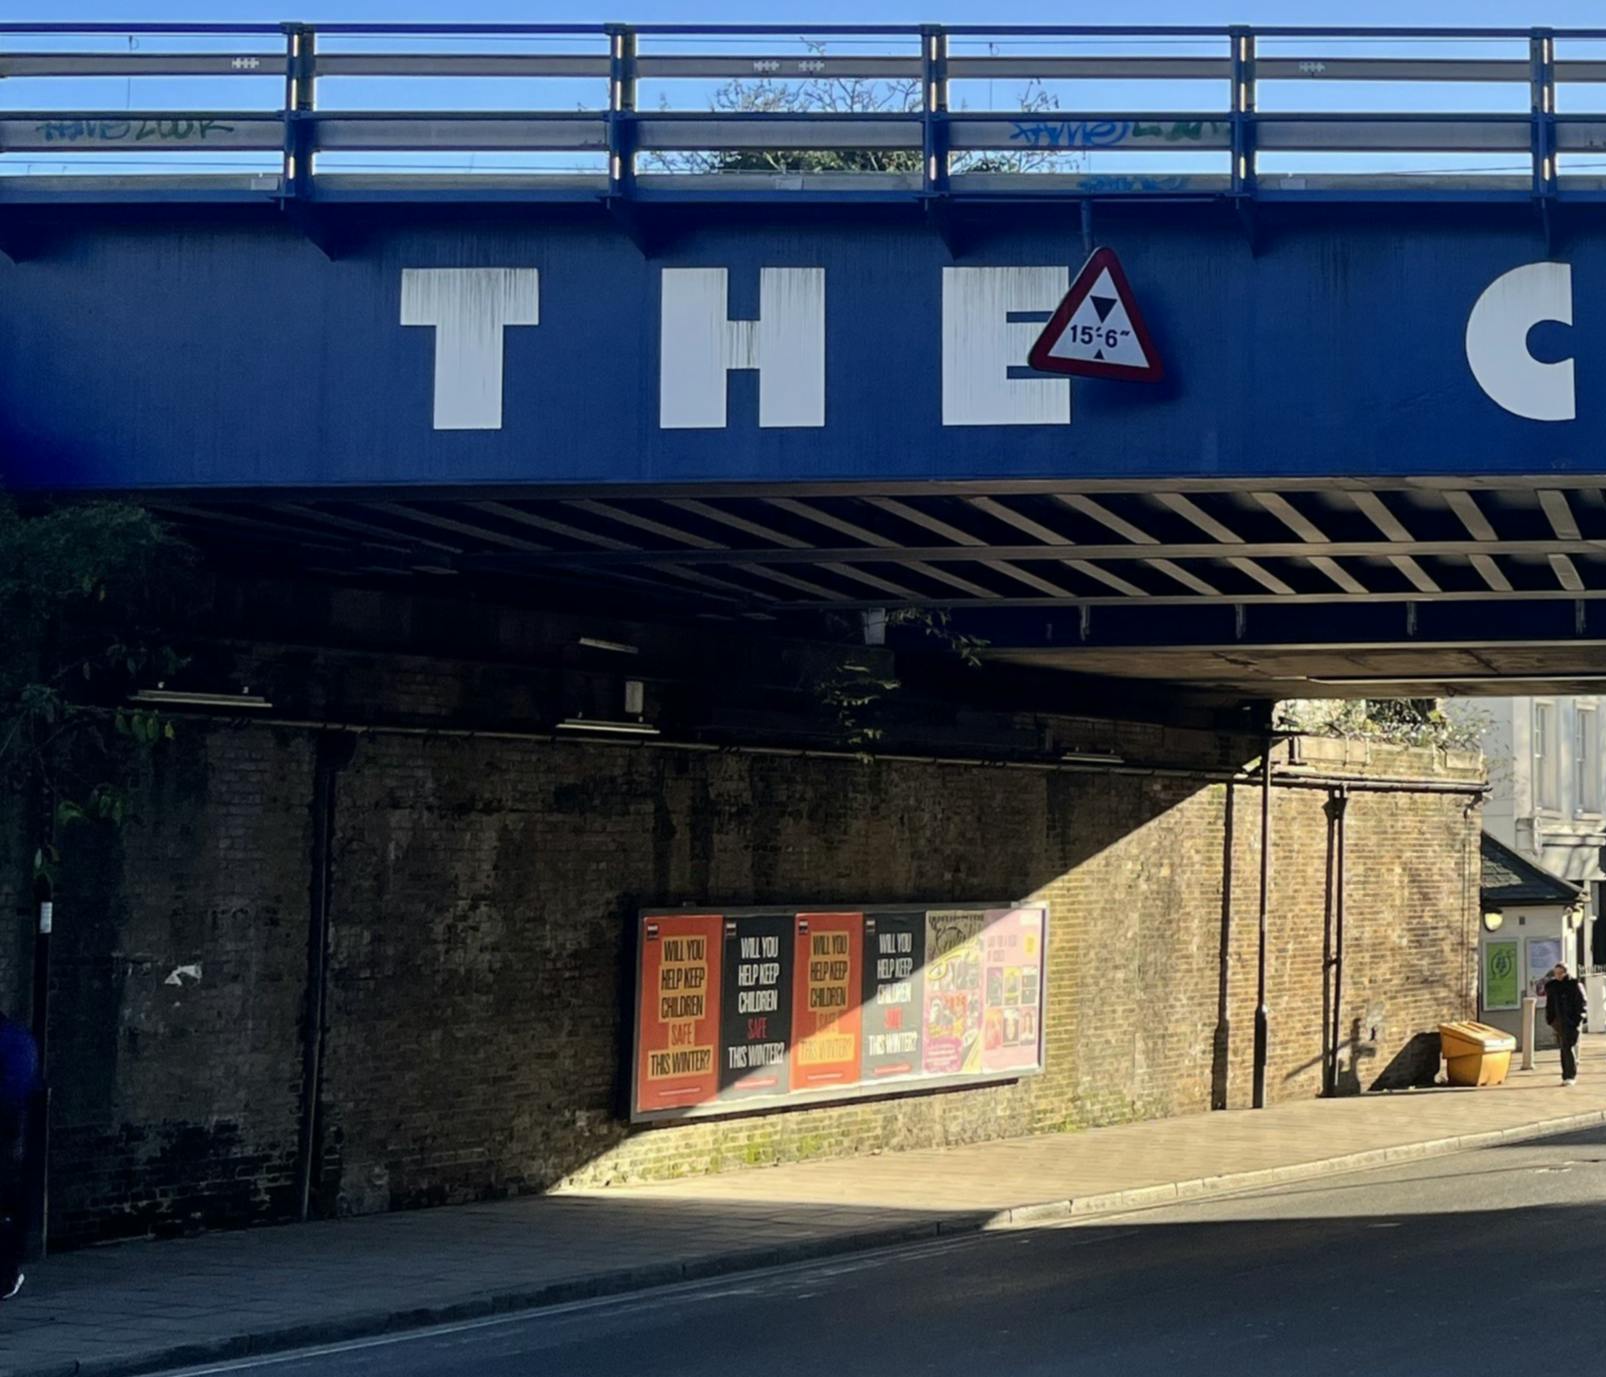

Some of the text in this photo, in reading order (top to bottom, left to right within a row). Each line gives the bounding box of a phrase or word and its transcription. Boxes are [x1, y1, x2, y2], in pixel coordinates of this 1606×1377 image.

[400, 266, 1071, 429] THE
[664, 939, 705, 962] WILL YOU
[741, 936, 779, 959] WILL YOU
[813, 934, 847, 956] WILL YOU
[879, 932, 912, 954] WILL YOU
[661, 967, 705, 991] HELP KEEP
[738, 962, 780, 986] HELP KEEP
[810, 960, 848, 982] HELP KEEP
[877, 957, 913, 980] HELP KEEP
[738, 989, 778, 1014] CHILDREN
[810, 986, 846, 1008] CHILDREN
[877, 982, 912, 1005] CHILDREN
[661, 995, 703, 1019] CHILDREN
[671, 1022, 692, 1046] SAFE
[747, 1018, 767, 1039] SAFE
[869, 1031, 918, 1056] THIS WINTER?
[651, 1050, 711, 1076] THIS WINTER?
[728, 1042, 785, 1069] THIS WINTER?
